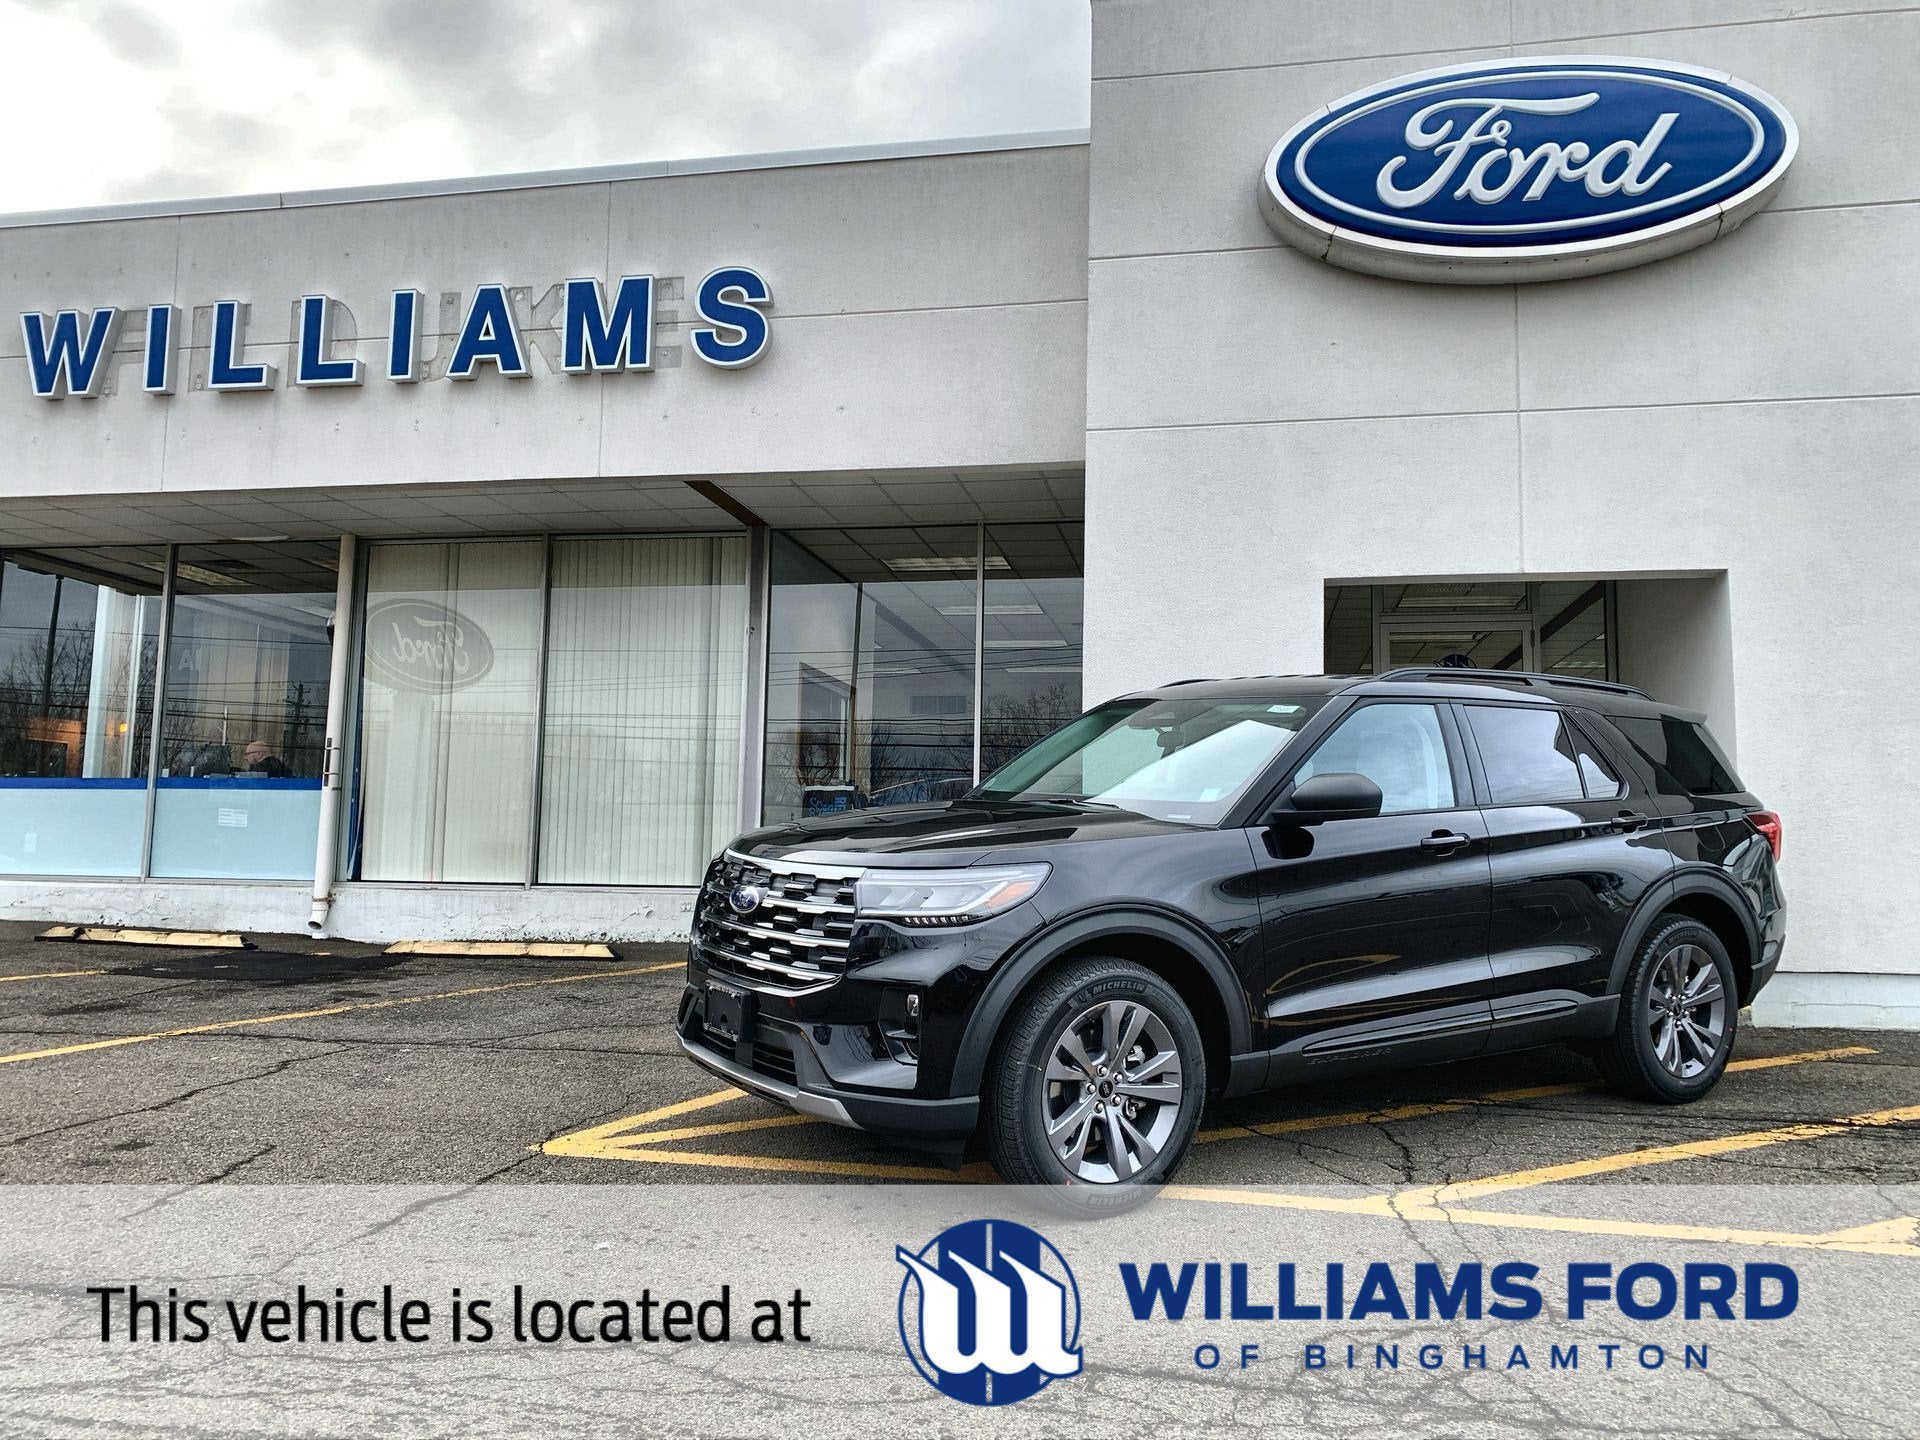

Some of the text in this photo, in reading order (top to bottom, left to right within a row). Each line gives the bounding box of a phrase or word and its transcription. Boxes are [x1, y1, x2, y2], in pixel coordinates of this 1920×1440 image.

[1376, 92, 1680, 208] Ford
[20, 266, 773, 398] WILLIAMS
[1093, 981, 1146, 994] MICHELIN
